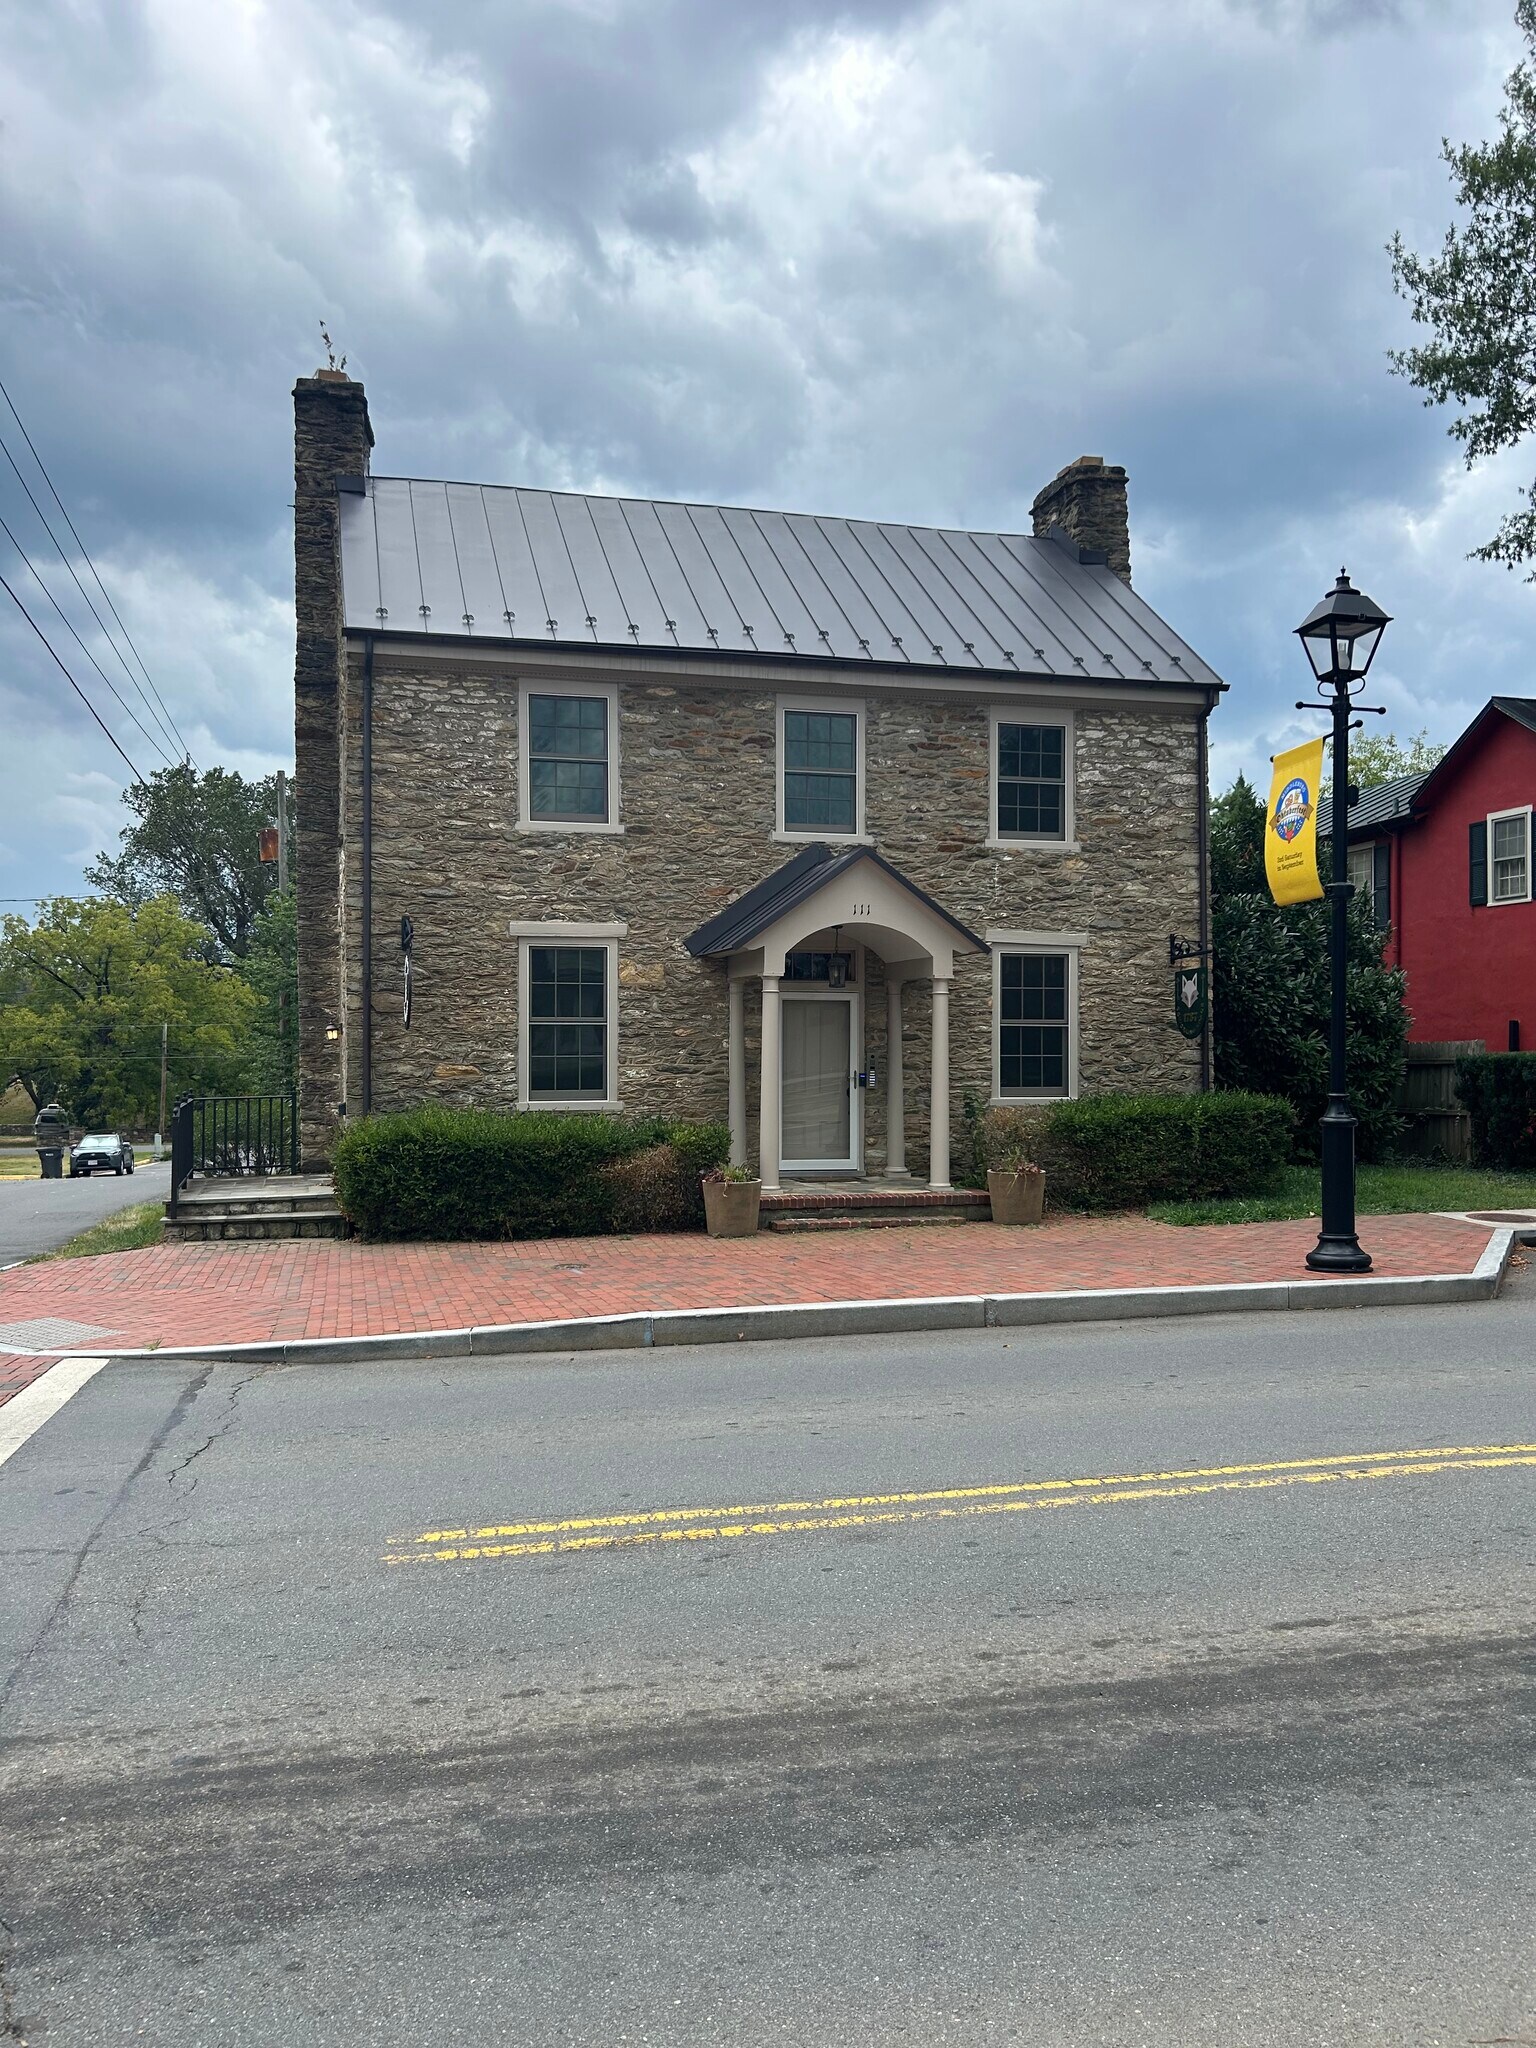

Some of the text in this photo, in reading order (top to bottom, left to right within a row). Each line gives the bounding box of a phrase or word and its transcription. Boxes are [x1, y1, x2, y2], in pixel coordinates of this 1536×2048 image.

[1284, 851, 1303, 861] Saturday
[1281, 860, 1304, 870] September
[853, 904, 871, 916] 111
